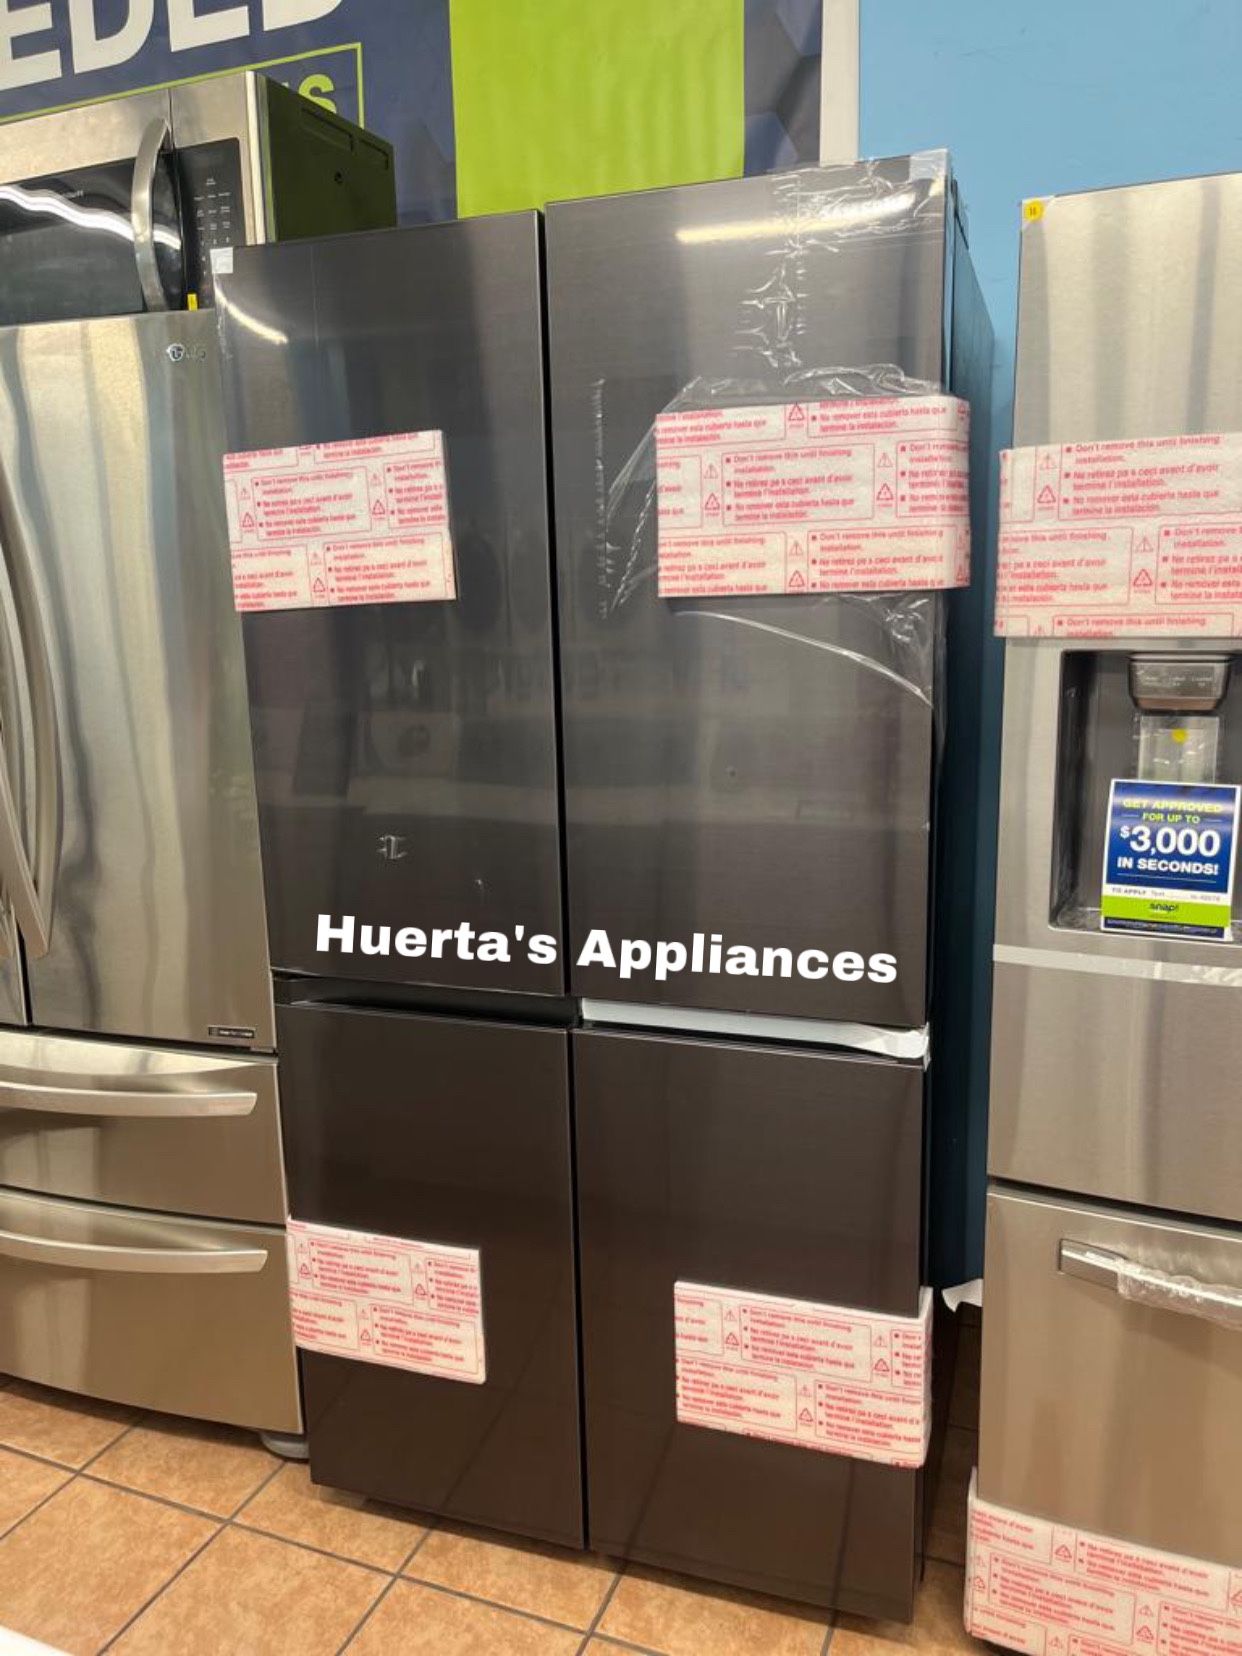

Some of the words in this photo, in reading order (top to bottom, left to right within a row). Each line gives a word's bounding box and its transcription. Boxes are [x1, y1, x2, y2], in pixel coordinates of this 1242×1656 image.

[1122, 798, 1148, 809] GET
[1152, 800, 1224, 813] APPROVED
[1142, 812, 1164, 821] FOR
[1166, 813, 1182, 822] UP
[1184, 814, 1200, 824] TO
[1120, 825, 1221, 857] $3,000
[1117, 856, 1133, 869] IN
[1137, 857, 1219, 876] SECONDS!
